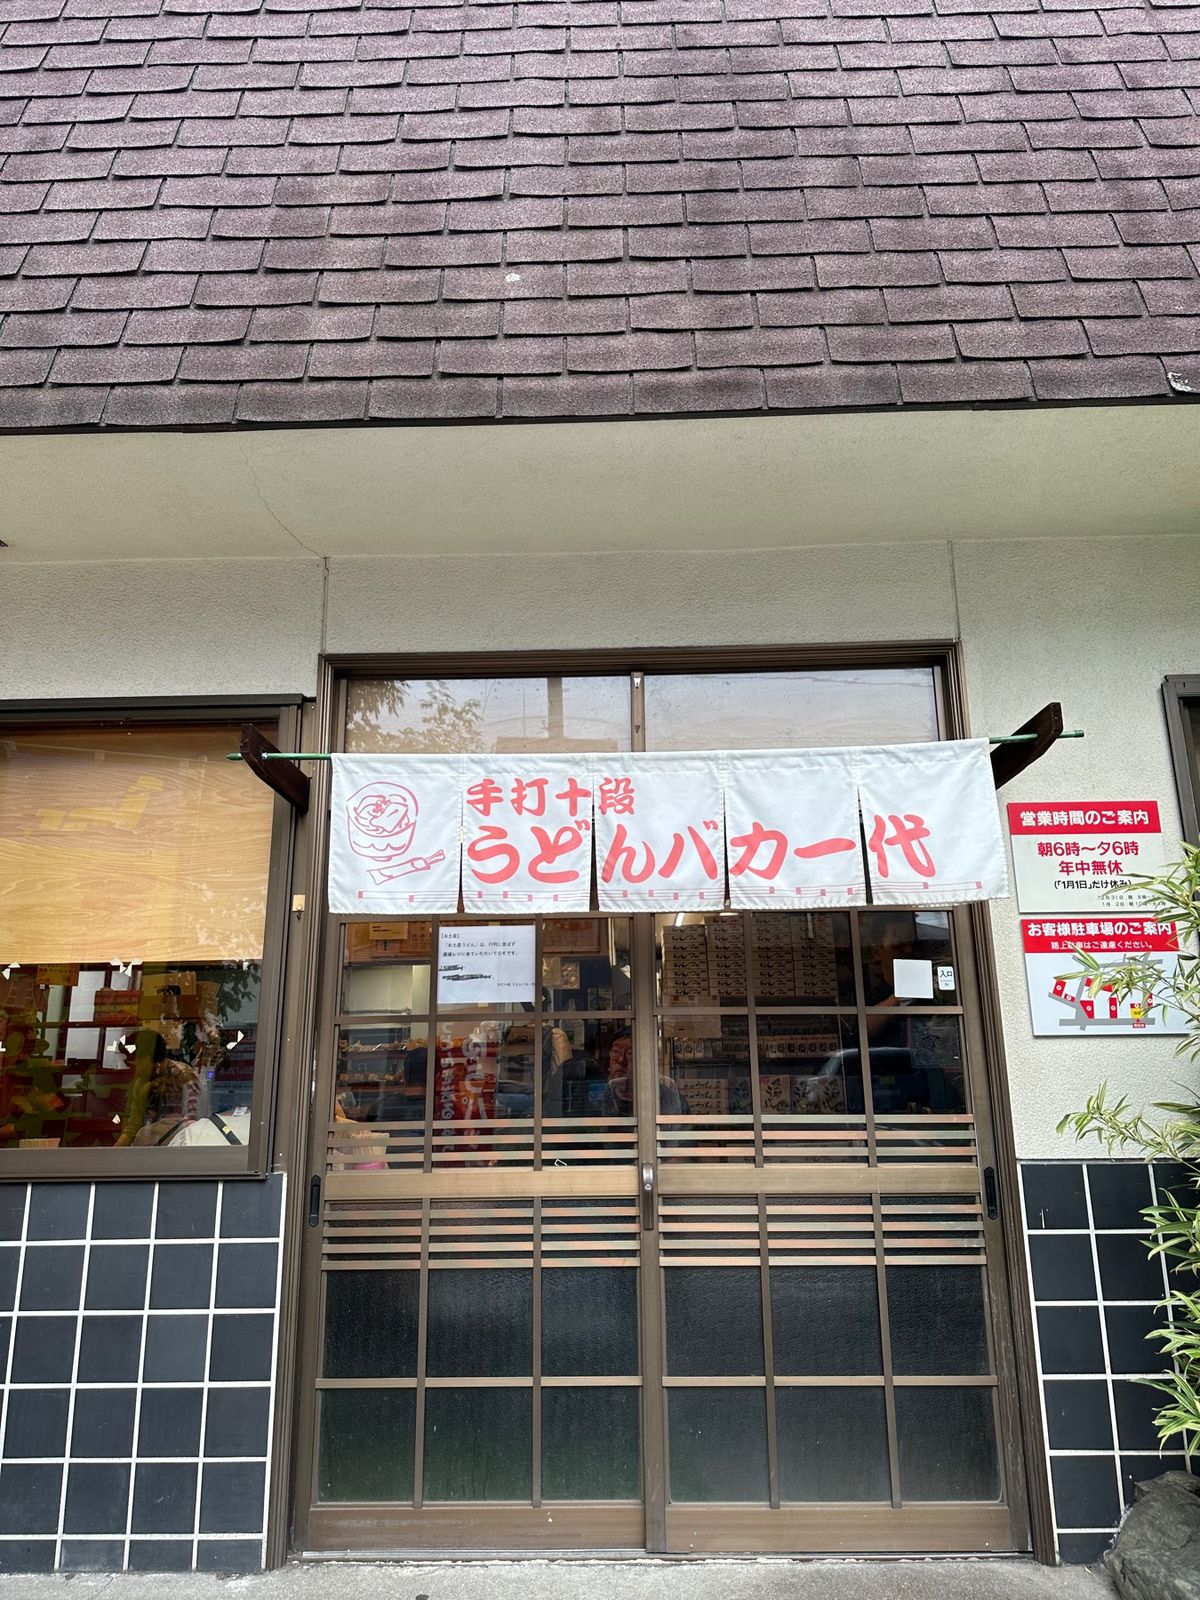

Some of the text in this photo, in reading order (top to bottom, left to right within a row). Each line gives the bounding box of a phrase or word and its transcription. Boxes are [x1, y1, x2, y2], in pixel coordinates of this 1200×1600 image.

[466, 777, 635, 816] 手打十段
[1020, 809, 1149, 827] 営業時間のご案内
[466, 814, 936, 884] うどんバカ一代
[1037, 841, 1139, 857] 朝6時〜夕6時
[1058, 860, 1123, 876] 年中無休
[1028, 922, 1172, 937] お客様駐車場のご案内
[940, 970, 953, 978] 入口
